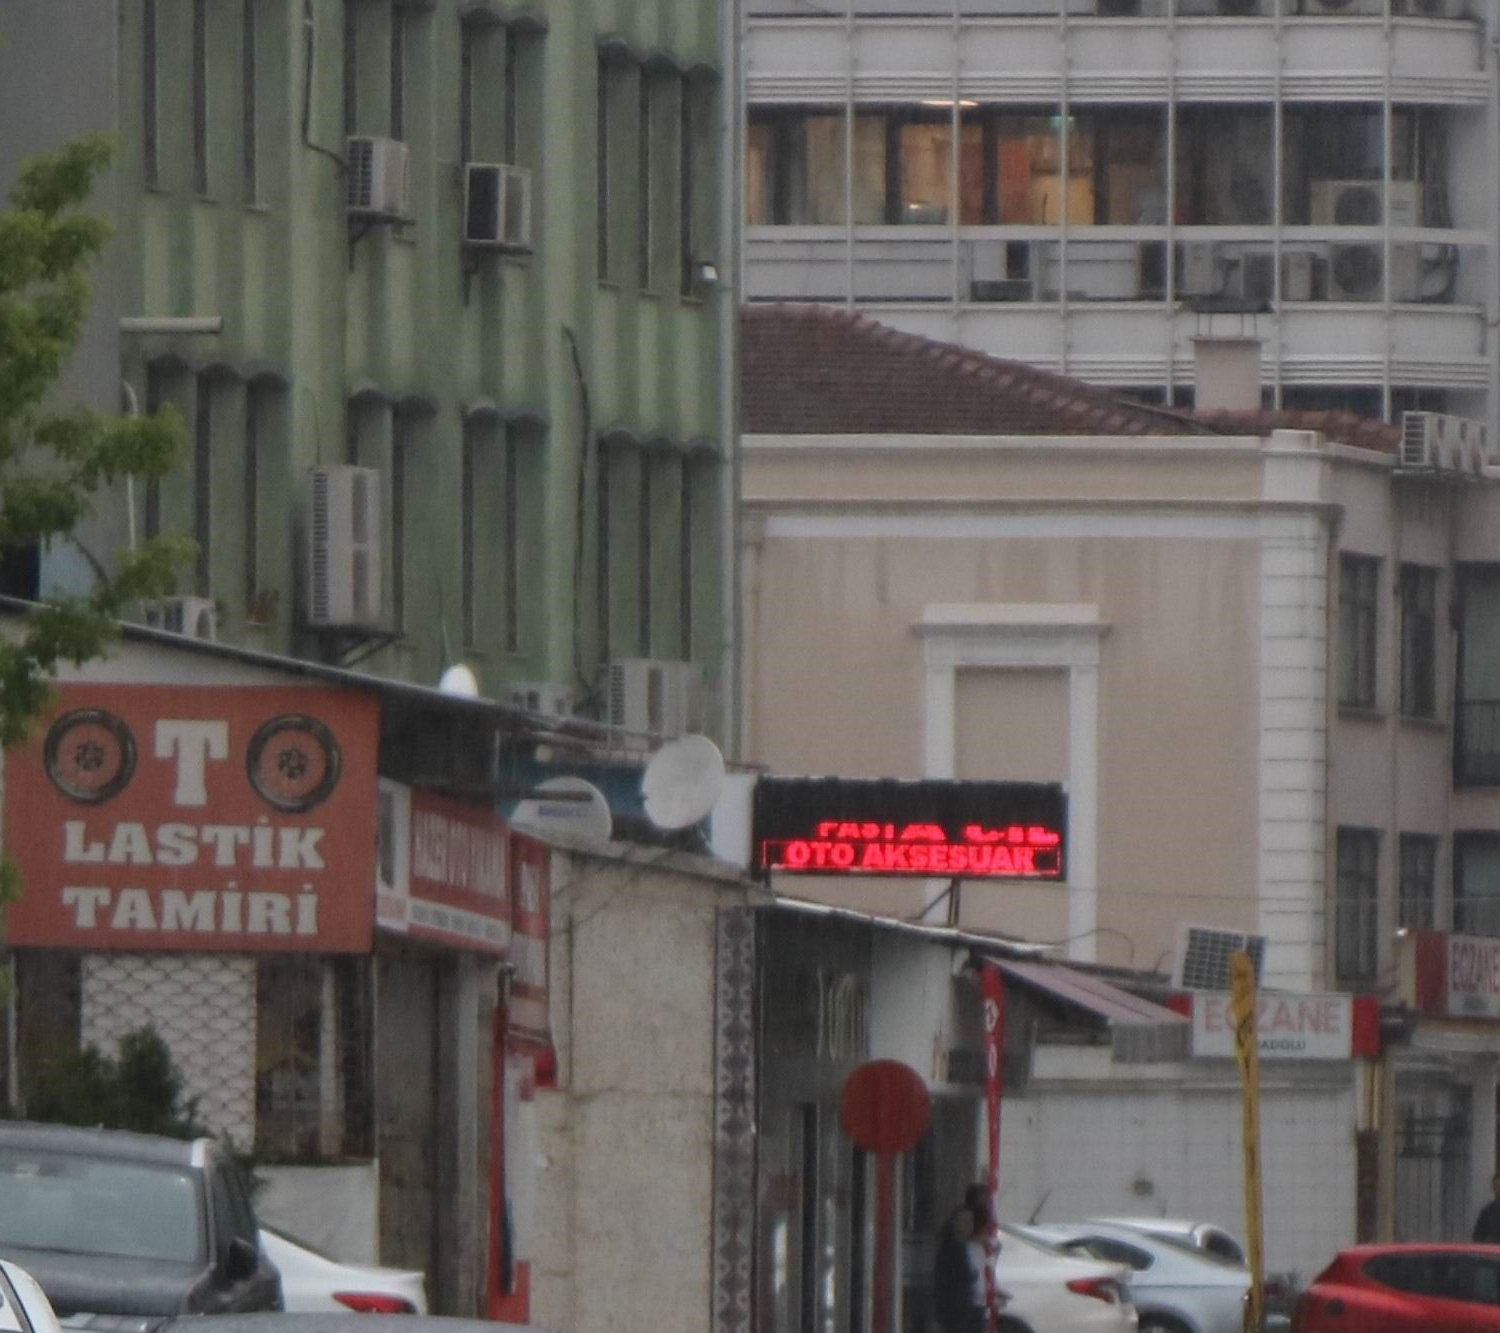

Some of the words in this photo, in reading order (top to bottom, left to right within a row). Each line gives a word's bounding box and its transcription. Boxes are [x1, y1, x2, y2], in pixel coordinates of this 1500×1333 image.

[63, 815, 326, 869] LASTİK
[785, 841, 855, 867] OTO
[62, 881, 319, 935] TAMİRİ
